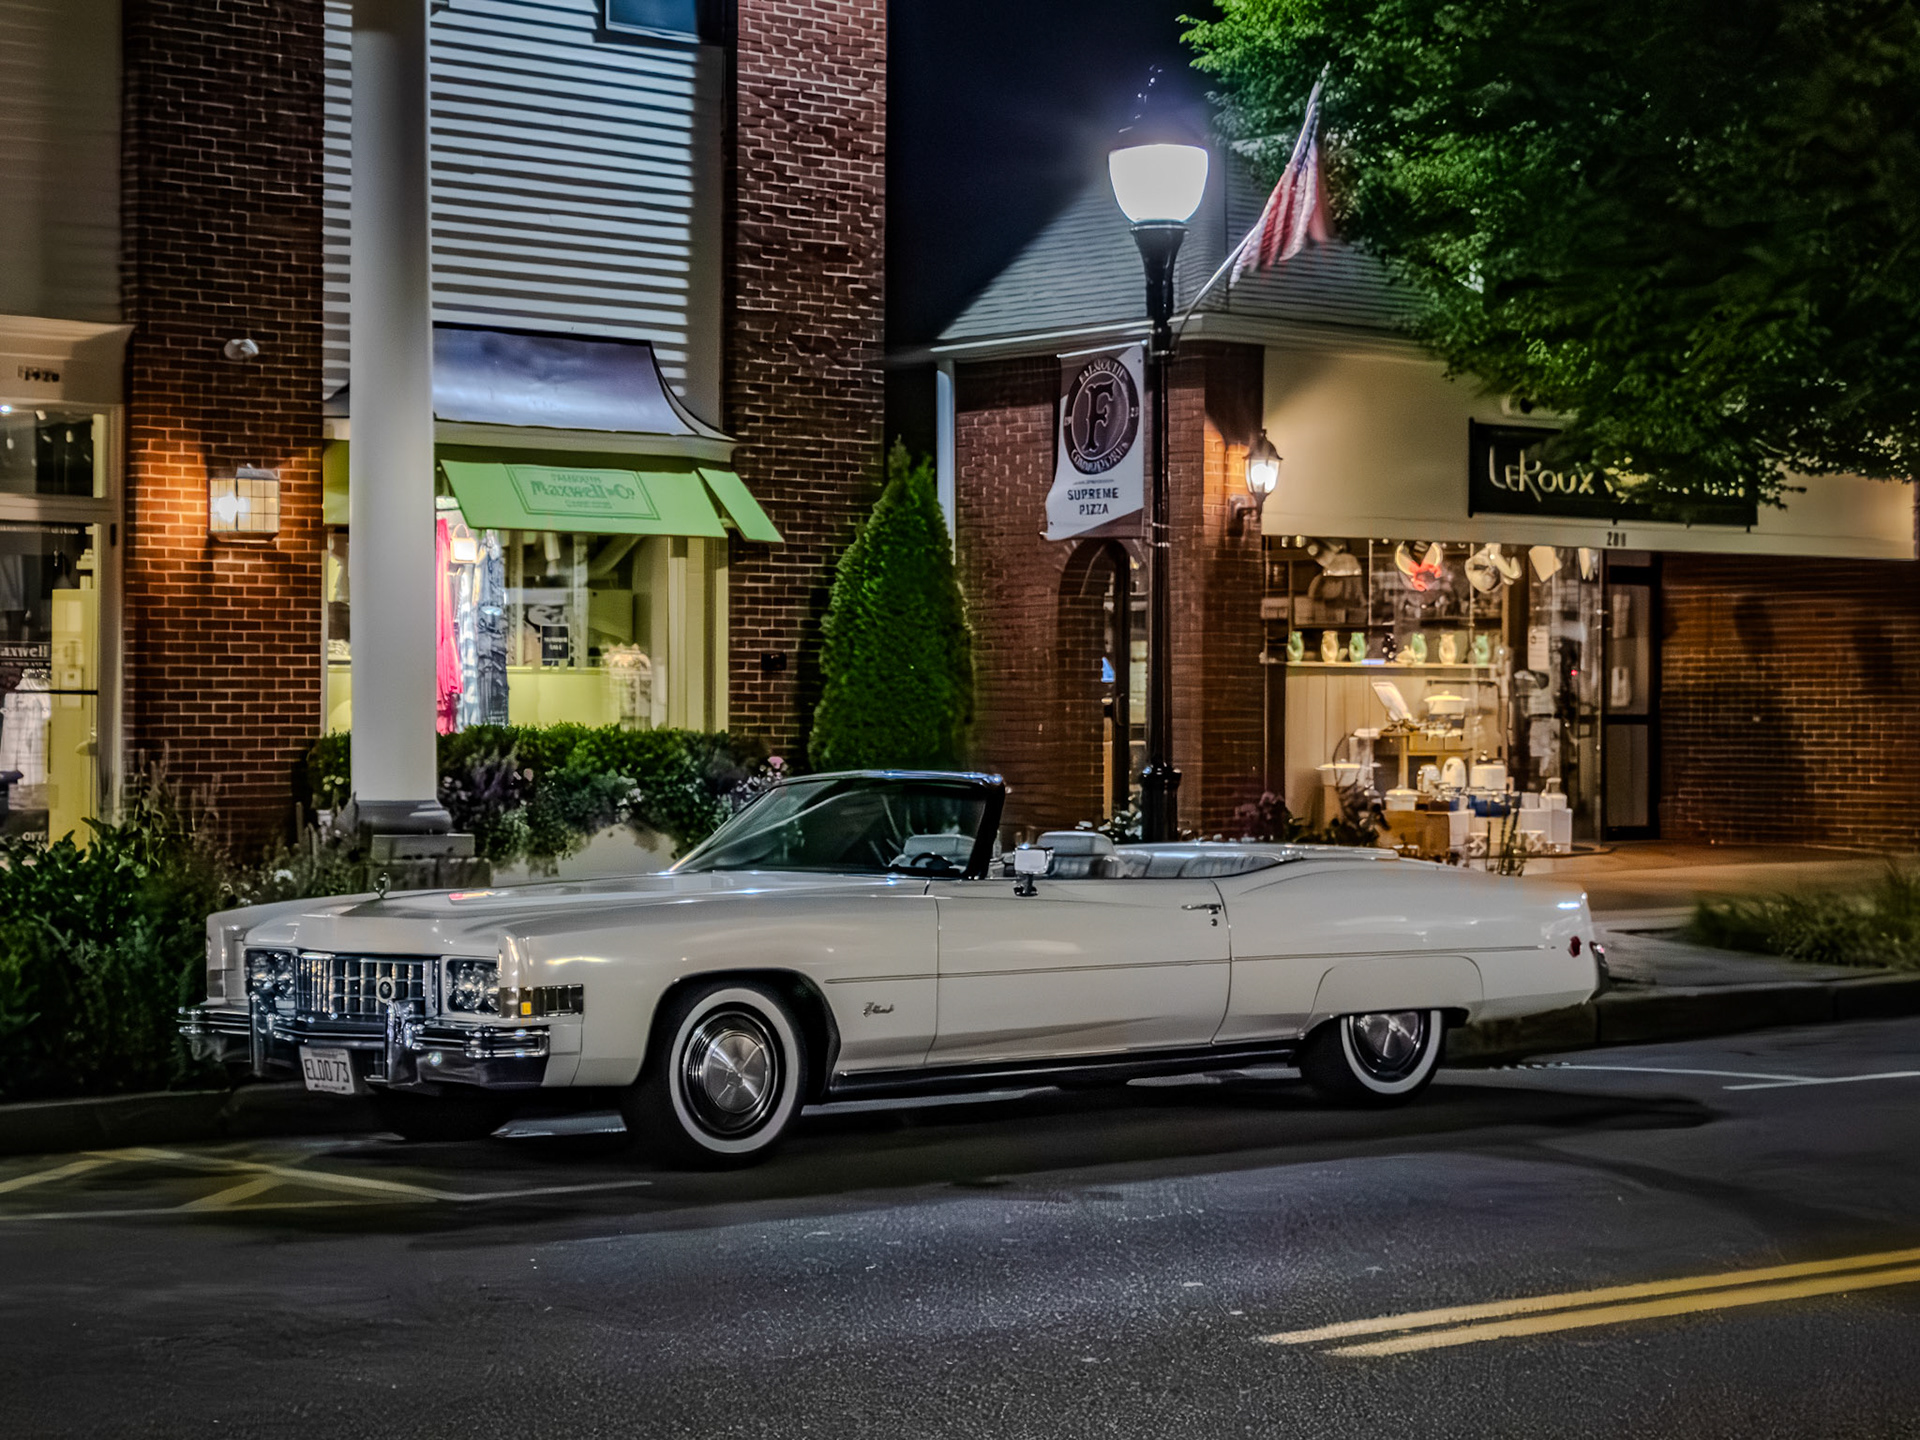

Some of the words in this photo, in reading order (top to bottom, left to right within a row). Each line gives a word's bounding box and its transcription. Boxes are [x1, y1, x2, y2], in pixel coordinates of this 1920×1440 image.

[530, 480, 607, 499] Maxwell
[1067, 487, 1119, 501] SUPREME
[1079, 503, 1109, 515] PIZZA
